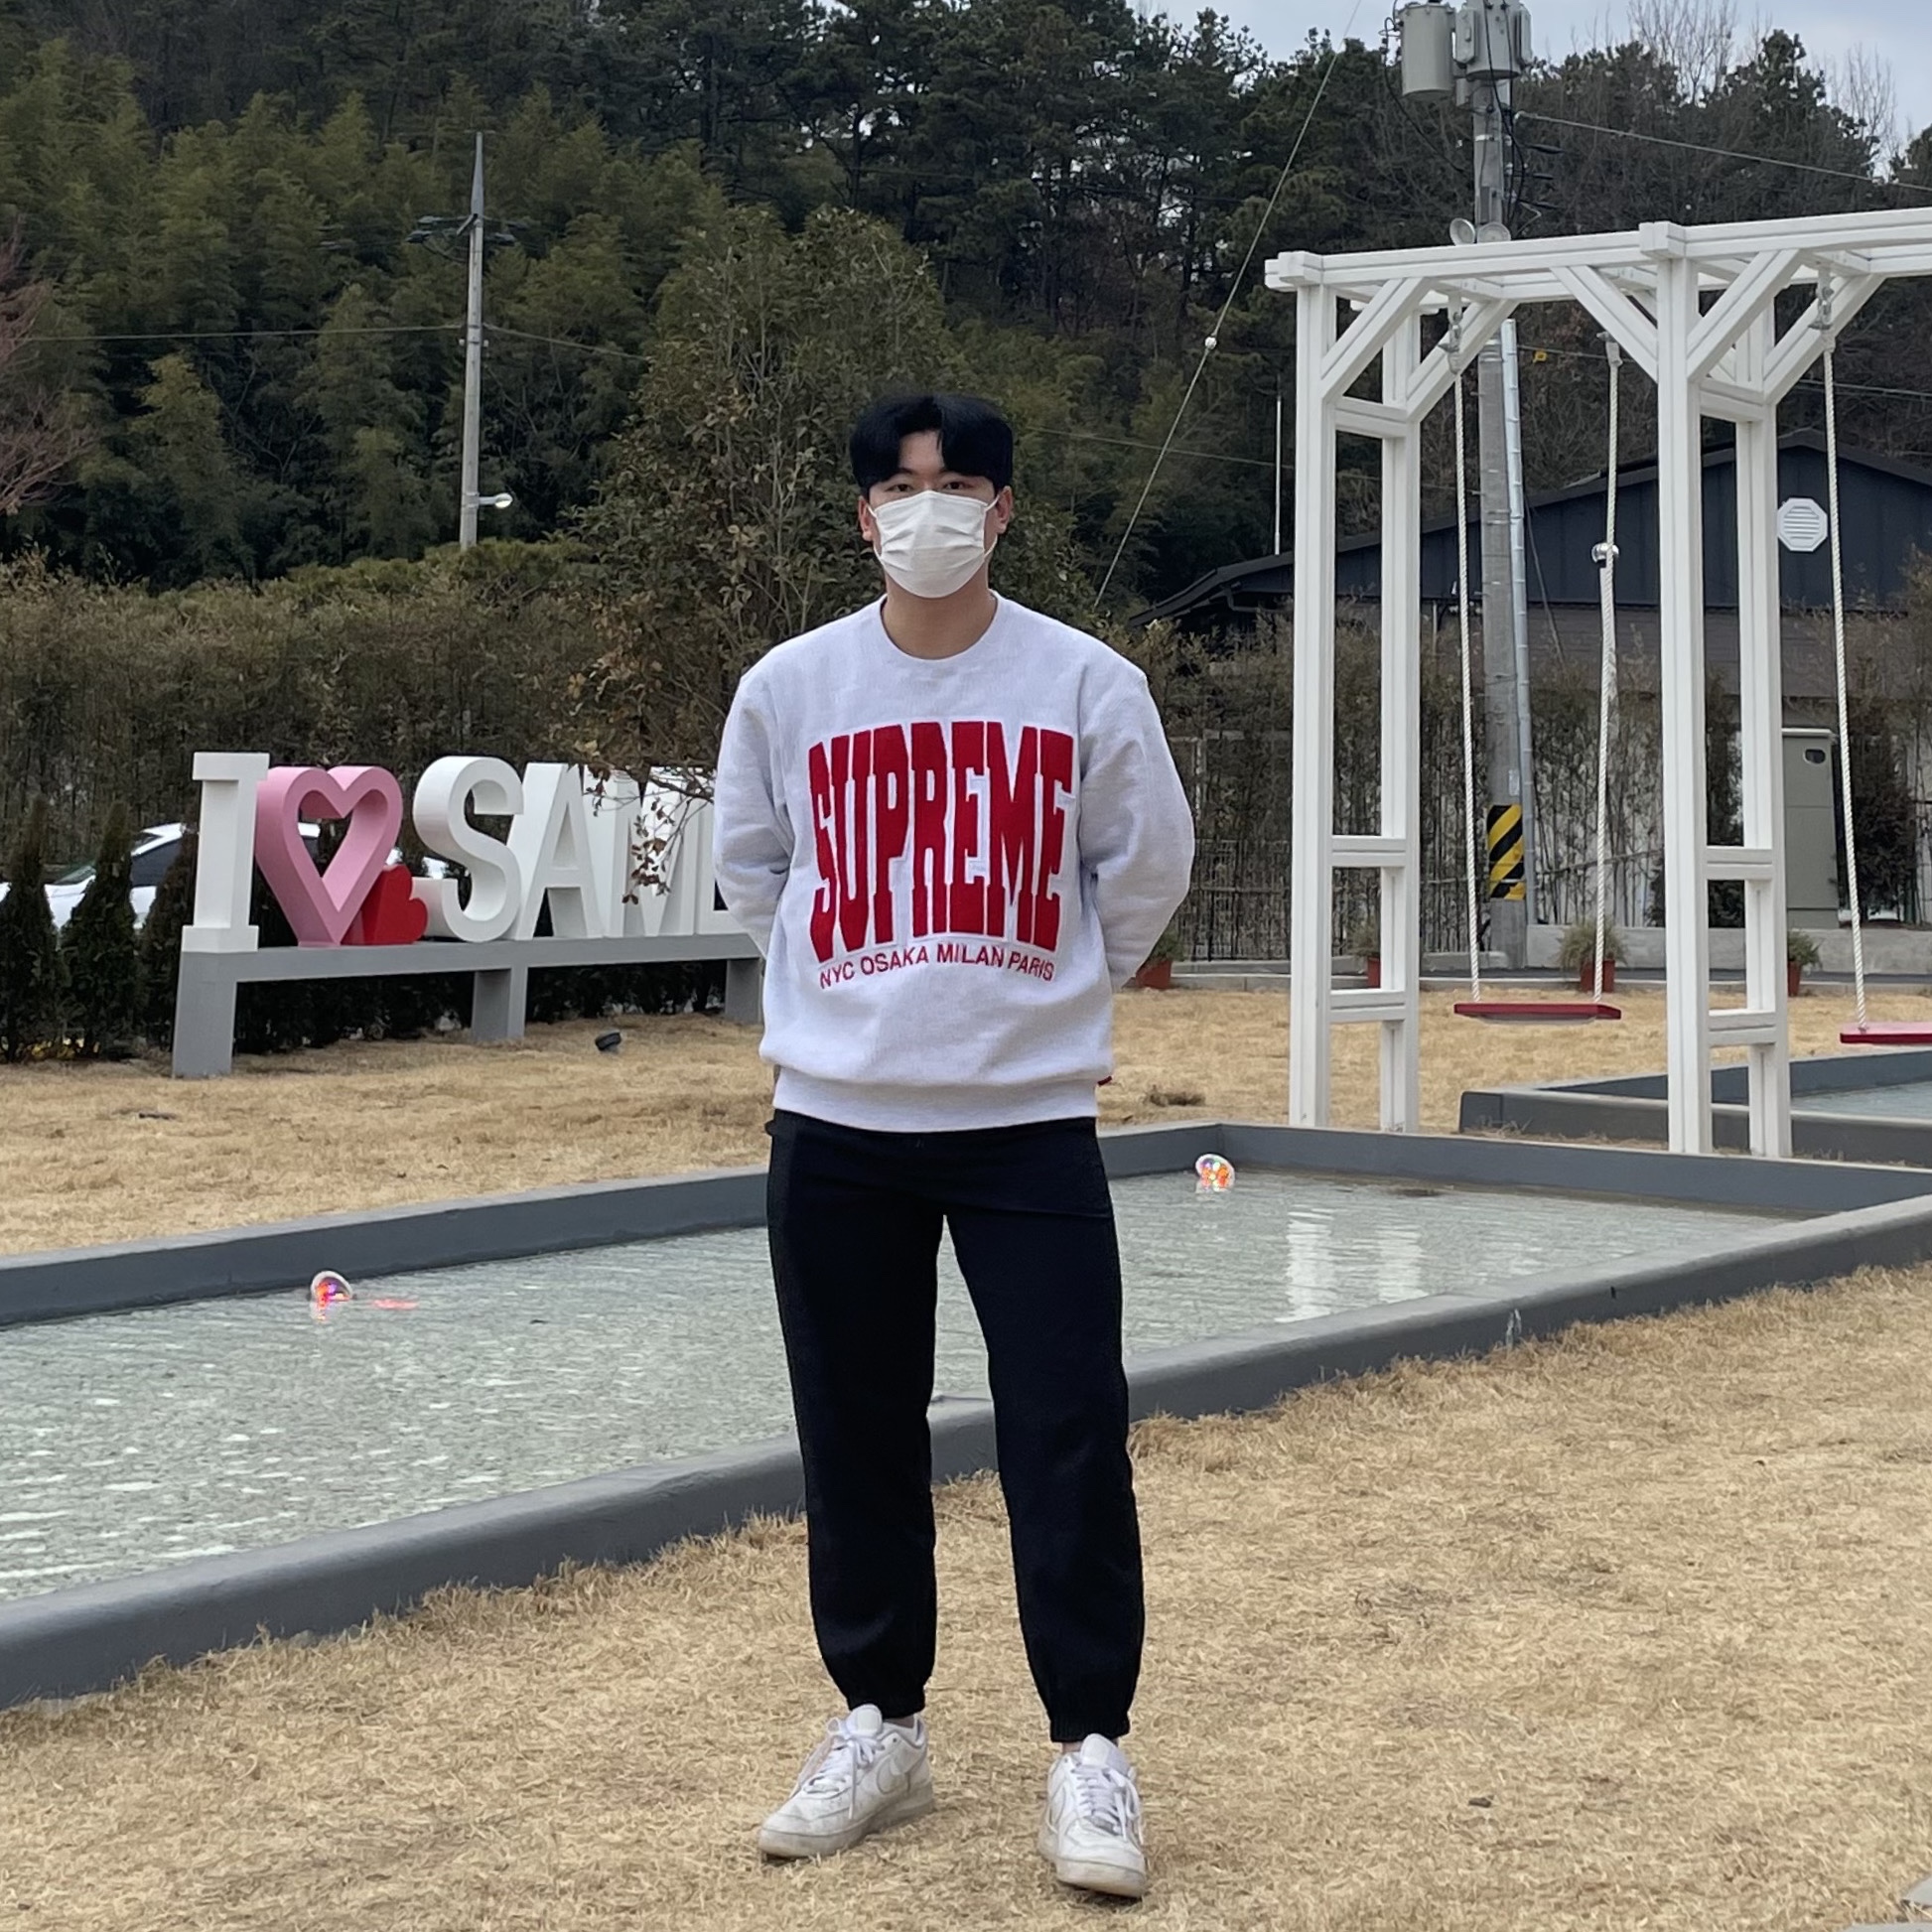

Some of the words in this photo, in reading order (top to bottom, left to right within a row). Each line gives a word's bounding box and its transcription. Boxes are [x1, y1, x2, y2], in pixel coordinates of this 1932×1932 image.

[182, 751, 269, 953] I
[807, 721, 1074, 963] SUPREME
[819, 961, 856, 990] NYC
[860, 946, 929, 976] OSAKA
[936, 943, 1004, 968] MILAN
[1007, 950, 1055, 982] PARIS
